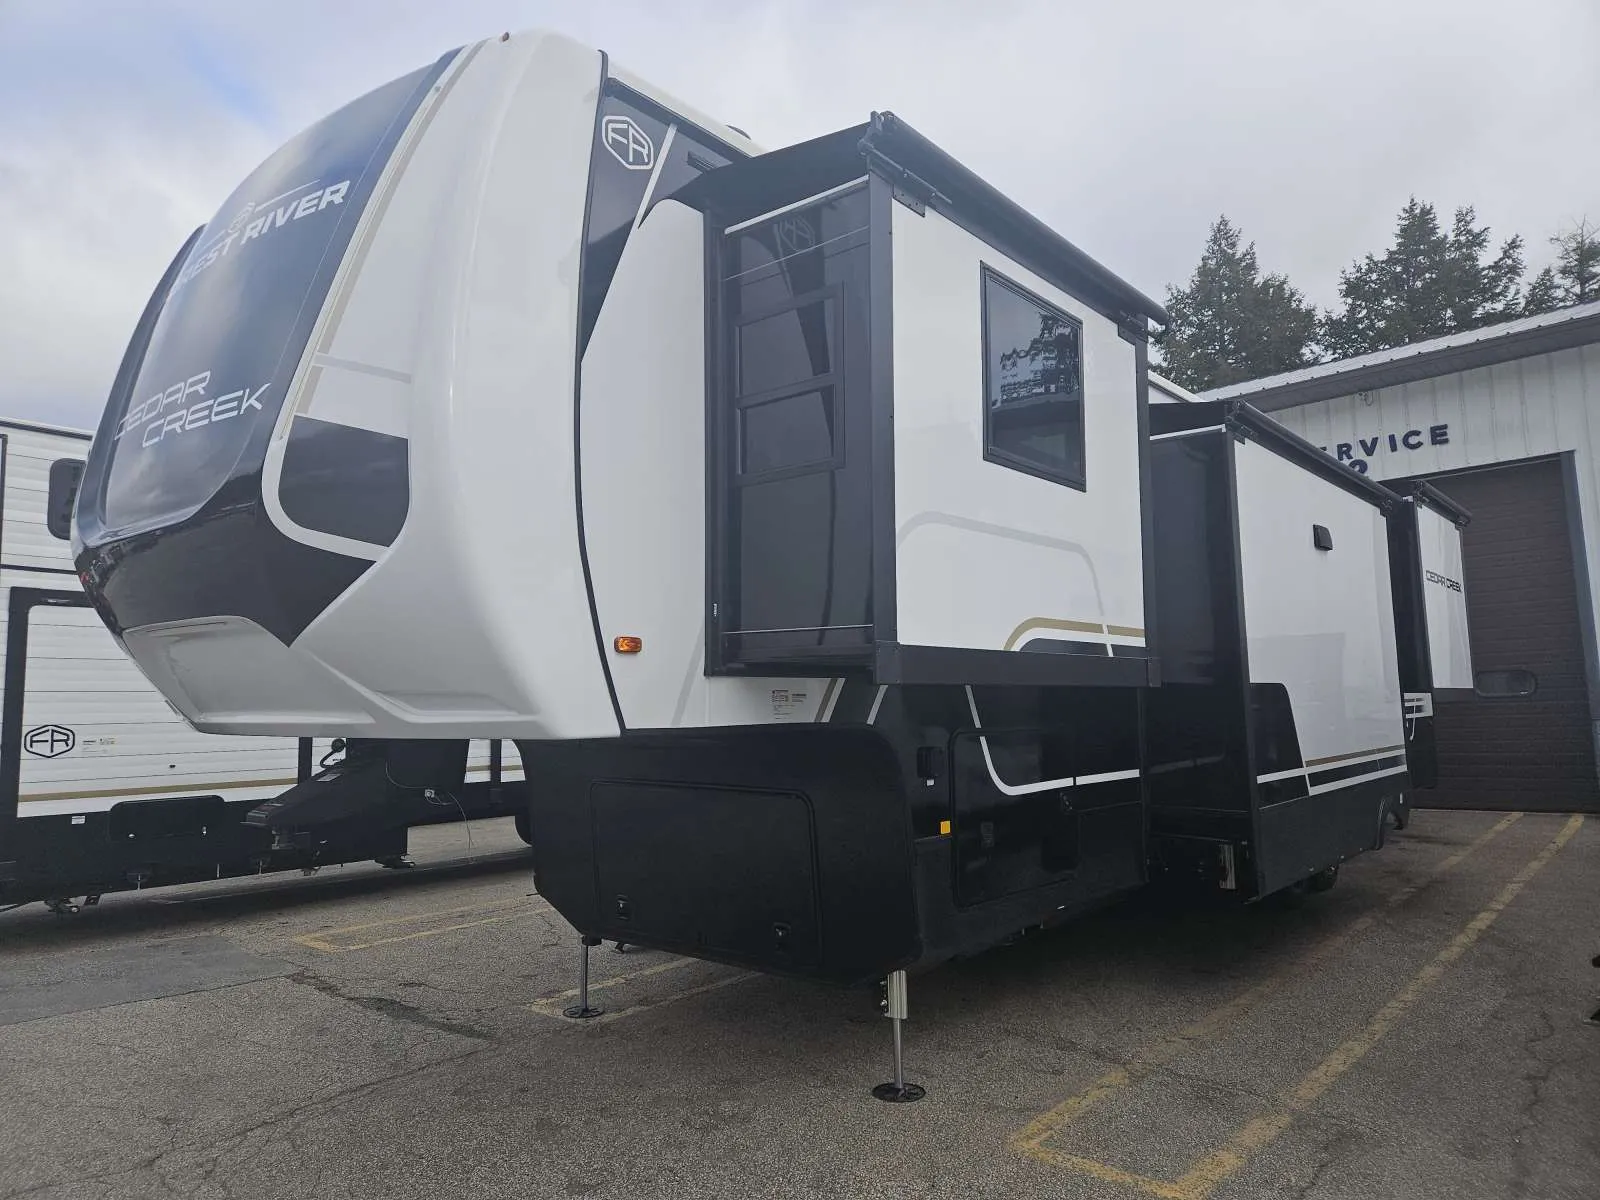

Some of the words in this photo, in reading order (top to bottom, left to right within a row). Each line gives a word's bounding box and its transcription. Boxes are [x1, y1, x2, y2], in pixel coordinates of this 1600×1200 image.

[241, 180, 350, 246] RIVER
[114, 371, 211, 441] CEDAR
[142, 382, 271, 448] CREEK
[1320, 423, 1449, 461] RVICE
